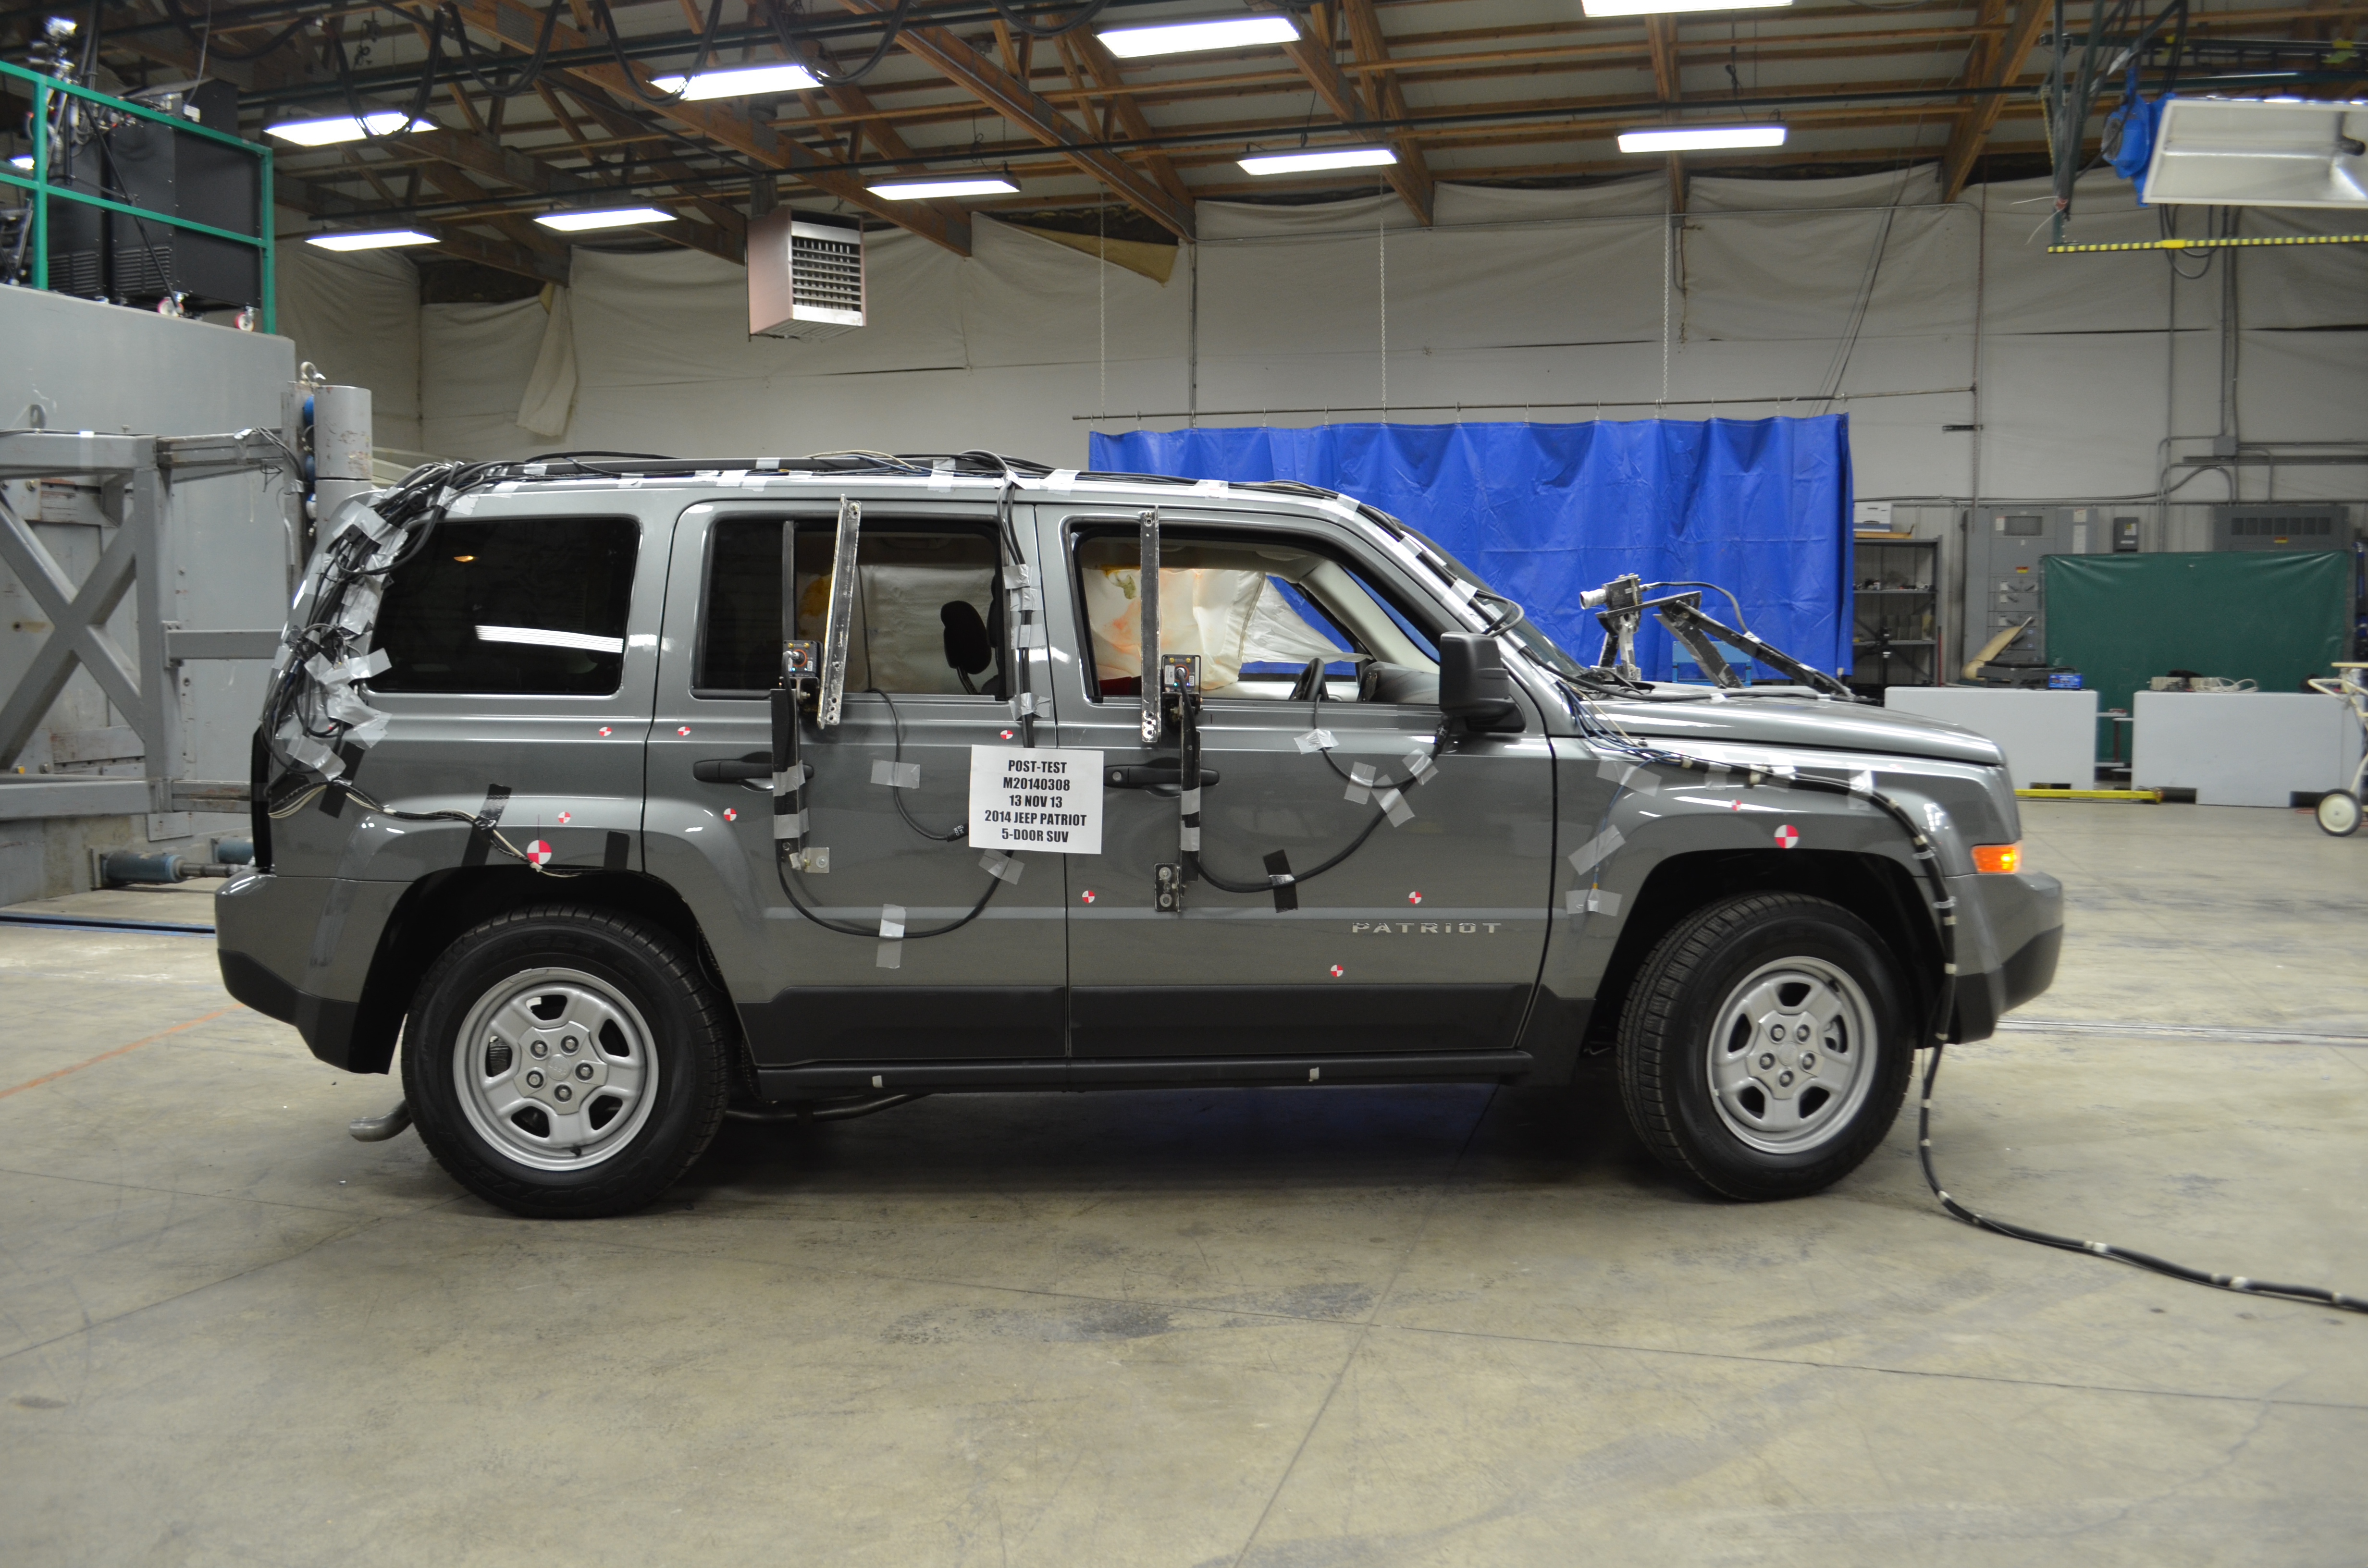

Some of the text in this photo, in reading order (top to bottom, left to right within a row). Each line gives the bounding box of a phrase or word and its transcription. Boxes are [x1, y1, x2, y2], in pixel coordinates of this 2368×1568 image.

[1008, 760, 1067, 773] POST-TEST
[1003, 777, 1070, 791] M20140308
[1009, 795, 1062, 808] 13 NOV 13
[985, 810, 1087, 826] 2014 JEEP PATRIOT
[1002, 828, 1069, 843] 5-DOOR SUV
[1352, 922, 1501, 933] PATRIOT
